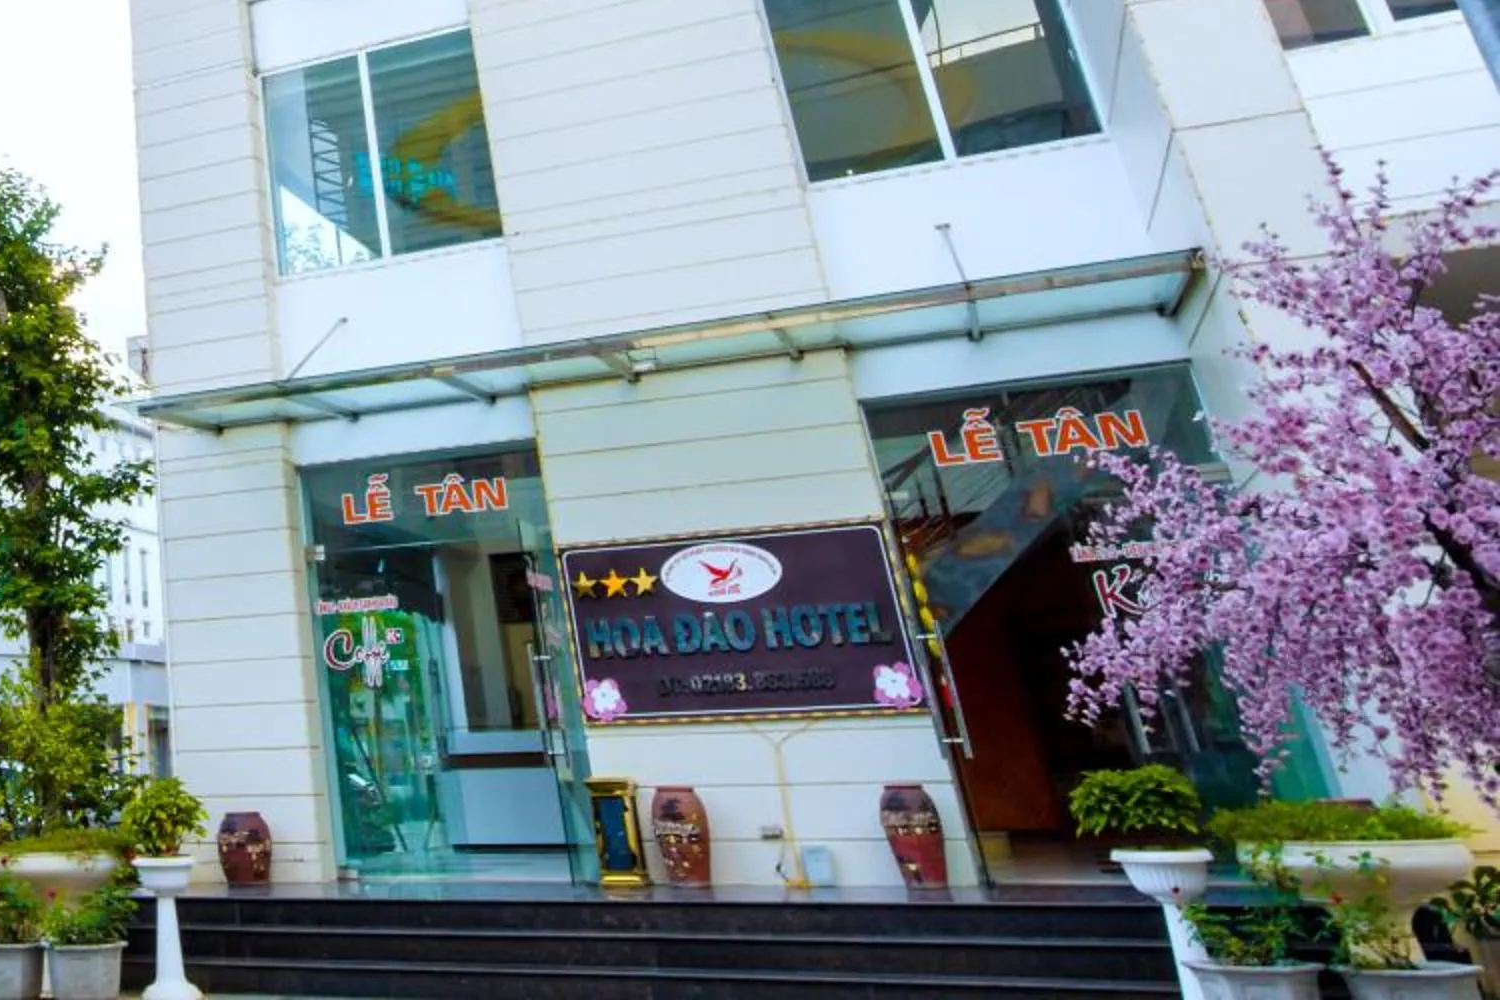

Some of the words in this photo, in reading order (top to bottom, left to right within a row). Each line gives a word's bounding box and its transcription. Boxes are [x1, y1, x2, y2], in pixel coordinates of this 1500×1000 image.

[927, 407, 1003, 467] LỄ
[1016, 406, 1149, 457] TÂN
[341, 473, 395, 525] LỄ
[414, 473, 509, 517] TÂN
[760, 601, 895, 650] HOTEL
